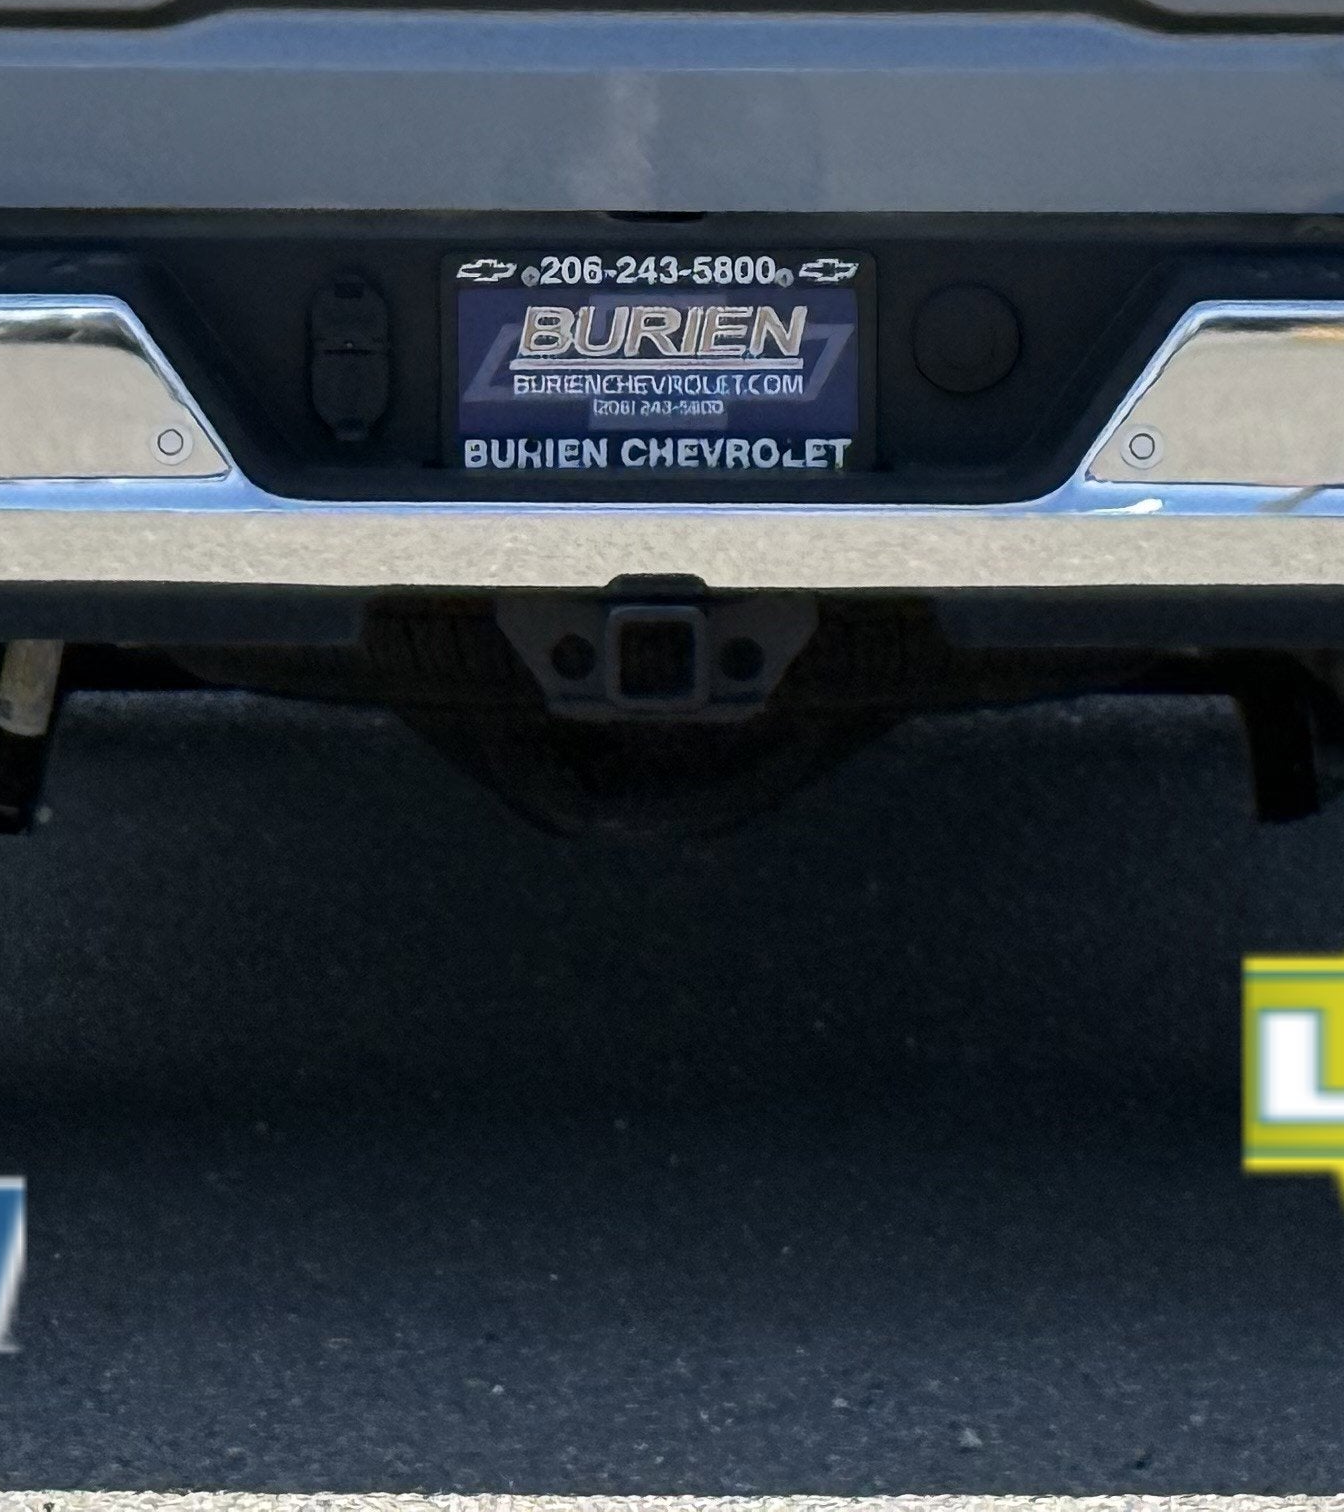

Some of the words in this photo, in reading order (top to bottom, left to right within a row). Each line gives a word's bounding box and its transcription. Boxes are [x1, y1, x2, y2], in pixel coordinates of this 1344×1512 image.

[539, 256, 776, 285] 206-243-5800
[517, 305, 808, 357] BURIEN
[513, 375, 803, 395] BURIENCHEVROLET.COM
[464, 438, 608, 469] BURIEN
